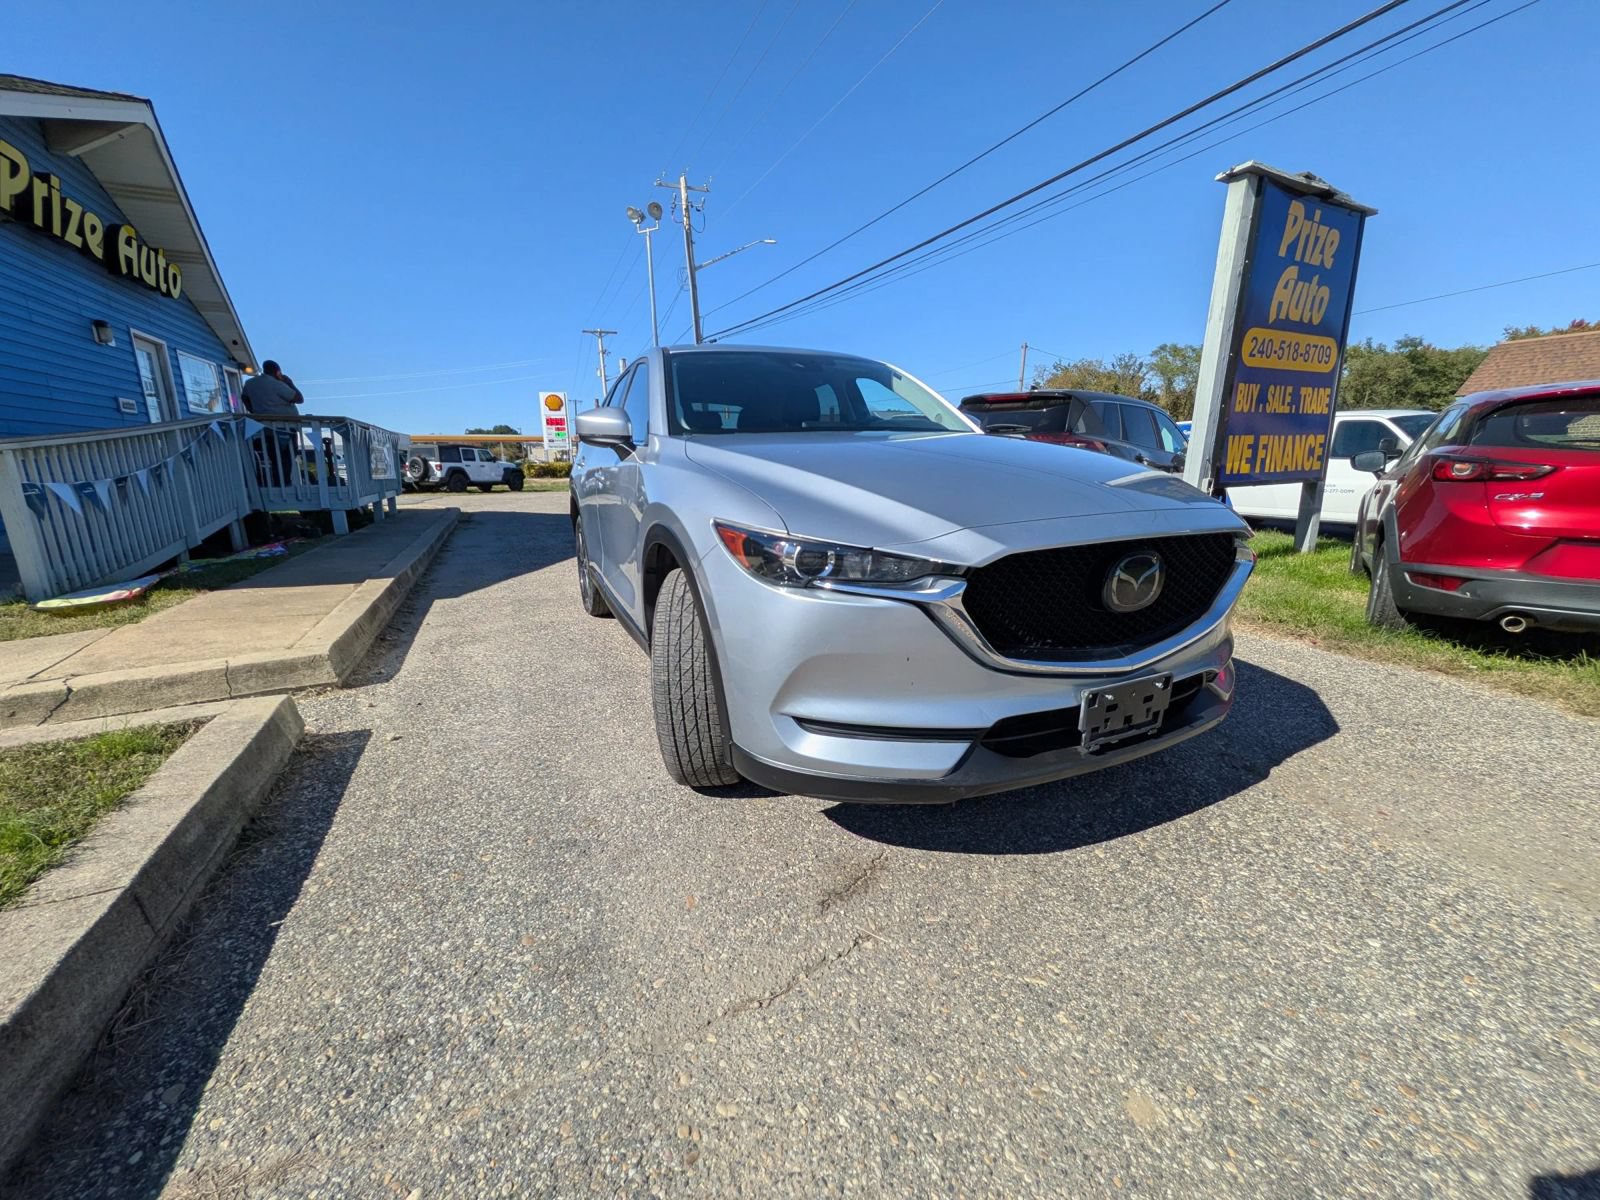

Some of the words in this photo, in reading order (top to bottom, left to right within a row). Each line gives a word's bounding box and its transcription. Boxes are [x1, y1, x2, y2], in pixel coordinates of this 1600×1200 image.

[0, 138, 105, 260] Prize
[117, 224, 183, 300] Auto
[1278, 199, 1340, 270] Prize
[1269, 265, 1330, 326] Auto
[1248, 336, 1332, 365] 240-518-8709
[1299, 387, 1331, 415] TRADE
[1225, 434, 1255, 475] WE
[1255, 433, 1326, 474] FINANCE
